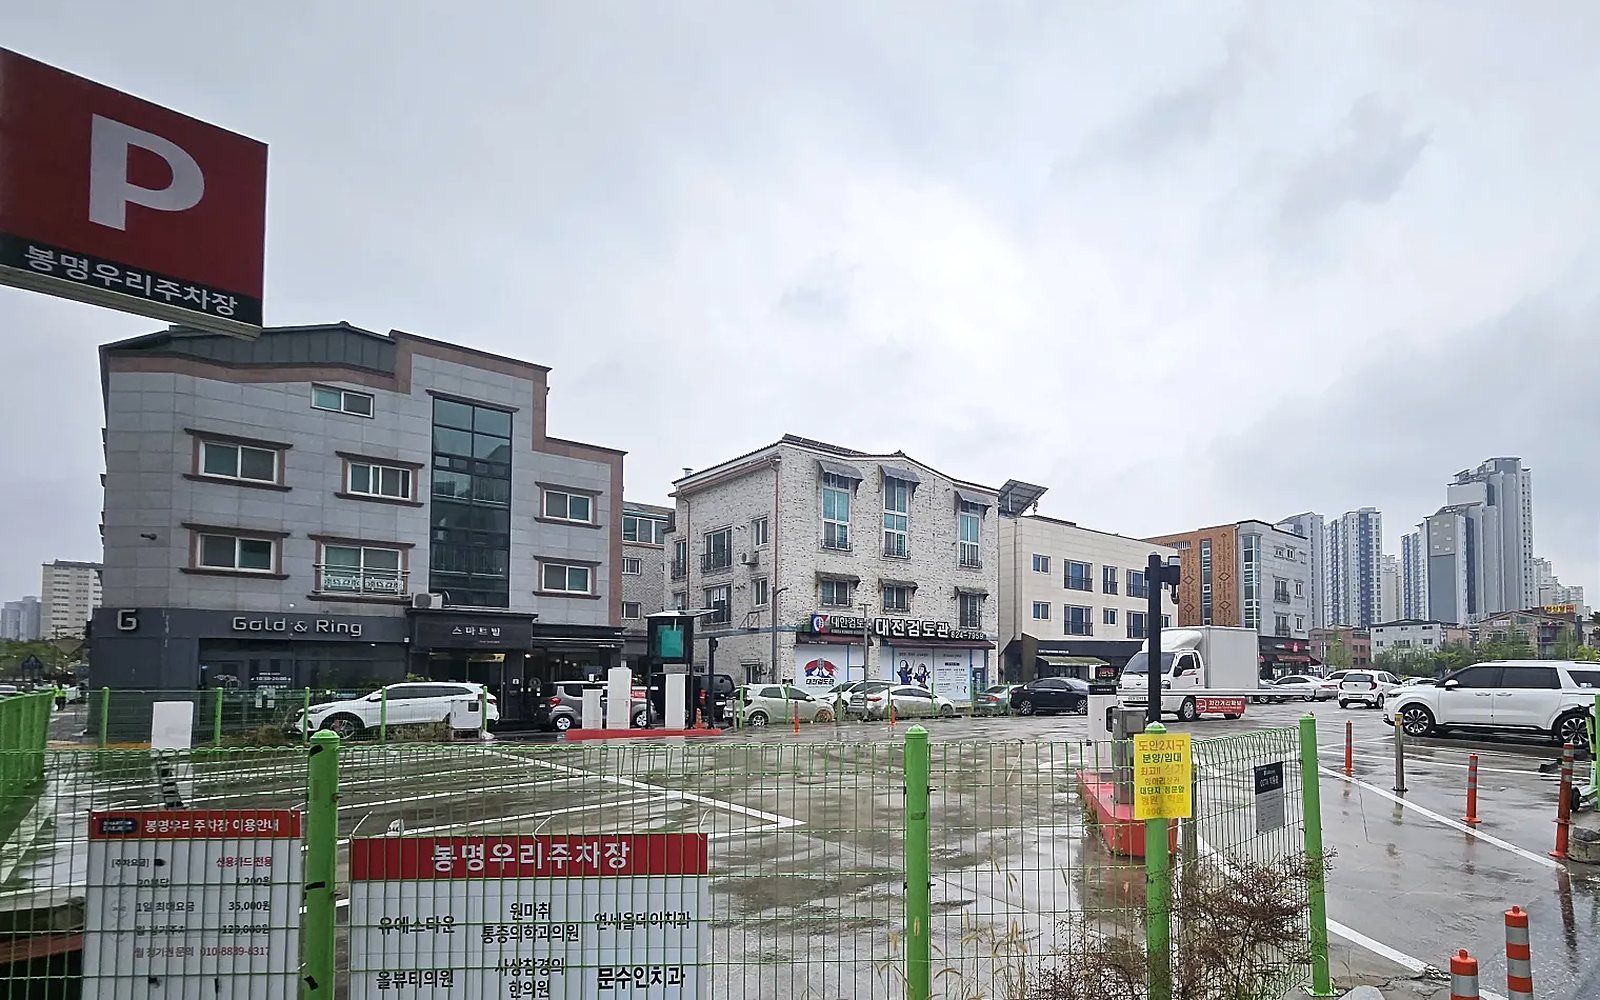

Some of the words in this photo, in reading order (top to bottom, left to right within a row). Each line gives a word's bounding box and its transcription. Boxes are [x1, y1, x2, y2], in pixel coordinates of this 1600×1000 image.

[88, 113, 205, 232] P
[24, 245, 238, 316] 봉명우리주차장
[116, 608, 137, 631] G
[232, 616, 286, 631] Gold
[294, 619, 308, 633] &
[316, 619, 362, 637] Ring
[875, 618, 949, 638] 대전검도관
[452, 625, 501, 637] 스마트빌
[1138, 739, 1185, 752] 도안2지구
[1142, 752, 1182, 764] 분양/임대
[1140, 786, 1161, 795] 대단지
[232, 818, 279, 833] 이용안내
[216, 856, 253, 868] 신용카드
[254, 856, 273, 868] 전용
[431, 841, 630, 872] 봉명우리주차장
[136, 901, 154, 912] 1일
[155, 901, 195, 912] 최대요금
[228, 900, 271, 911] 35,000원
[510, 902, 551, 921] 원마취
[378, 915, 457, 935] 유에스타운
[481, 923, 579, 944] 통증의학과의원
[376, 970, 454, 990] 올뷰티의원
[597, 966, 686, 990] 문수인치과
[508, 979, 550, 998] 한의원
